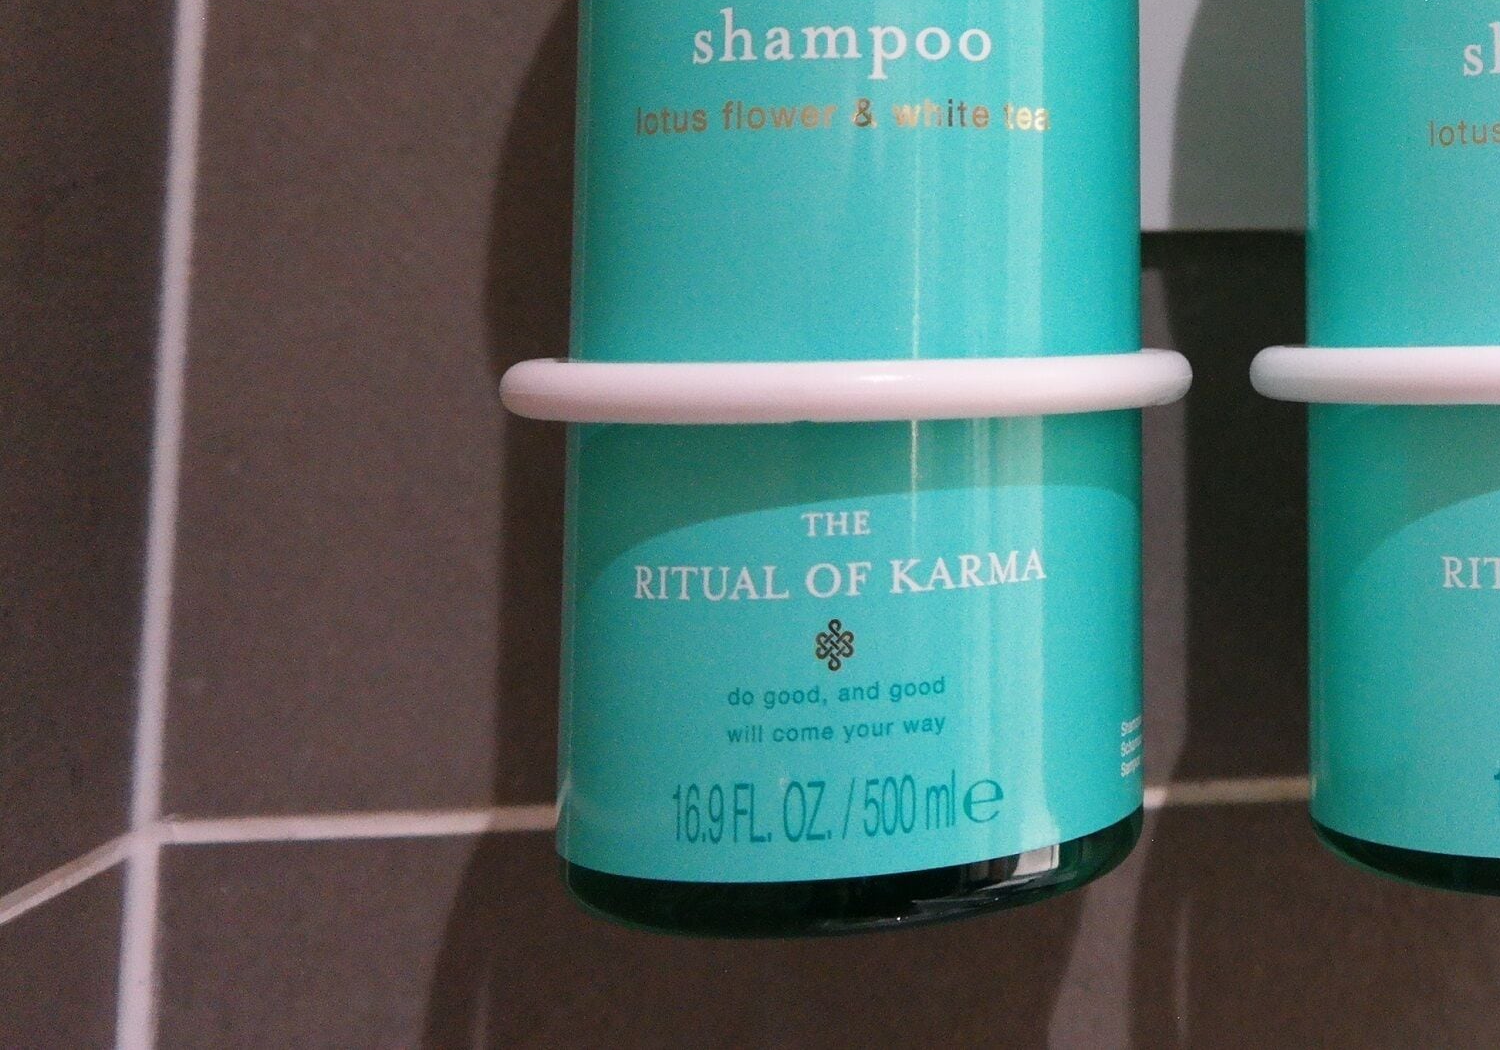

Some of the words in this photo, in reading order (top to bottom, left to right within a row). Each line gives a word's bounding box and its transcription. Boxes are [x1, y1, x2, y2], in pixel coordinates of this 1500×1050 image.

[692, 7, 992, 80] shampoo
[636, 106, 708, 135] lotus
[722, 99, 838, 130] flower
[852, 98, 877, 128] &
[893, 98, 990, 127] white
[1003, 101, 1051, 132] tea
[801, 511, 871, 537] THE
[634, 565, 789, 601] RITUAL
[805, 562, 872, 598] OF
[890, 549, 1047, 594] KARMA
[728, 687, 754, 706] do
[764, 687, 828, 709] good,
[838, 681, 880, 701] and
[889, 676, 945, 700] good
[728, 724, 763, 743] will
[773, 725, 833, 742] come
[844, 720, 893, 743] your
[903, 715, 945, 736] way
[672, 783, 725, 843] 16.9
[735, 782, 773, 843] FL.
[783, 780, 832, 843] OZ.
[842, 778, 857, 838] /
[863, 774, 914, 836] 500
[925, 768, 956, 830] ml
